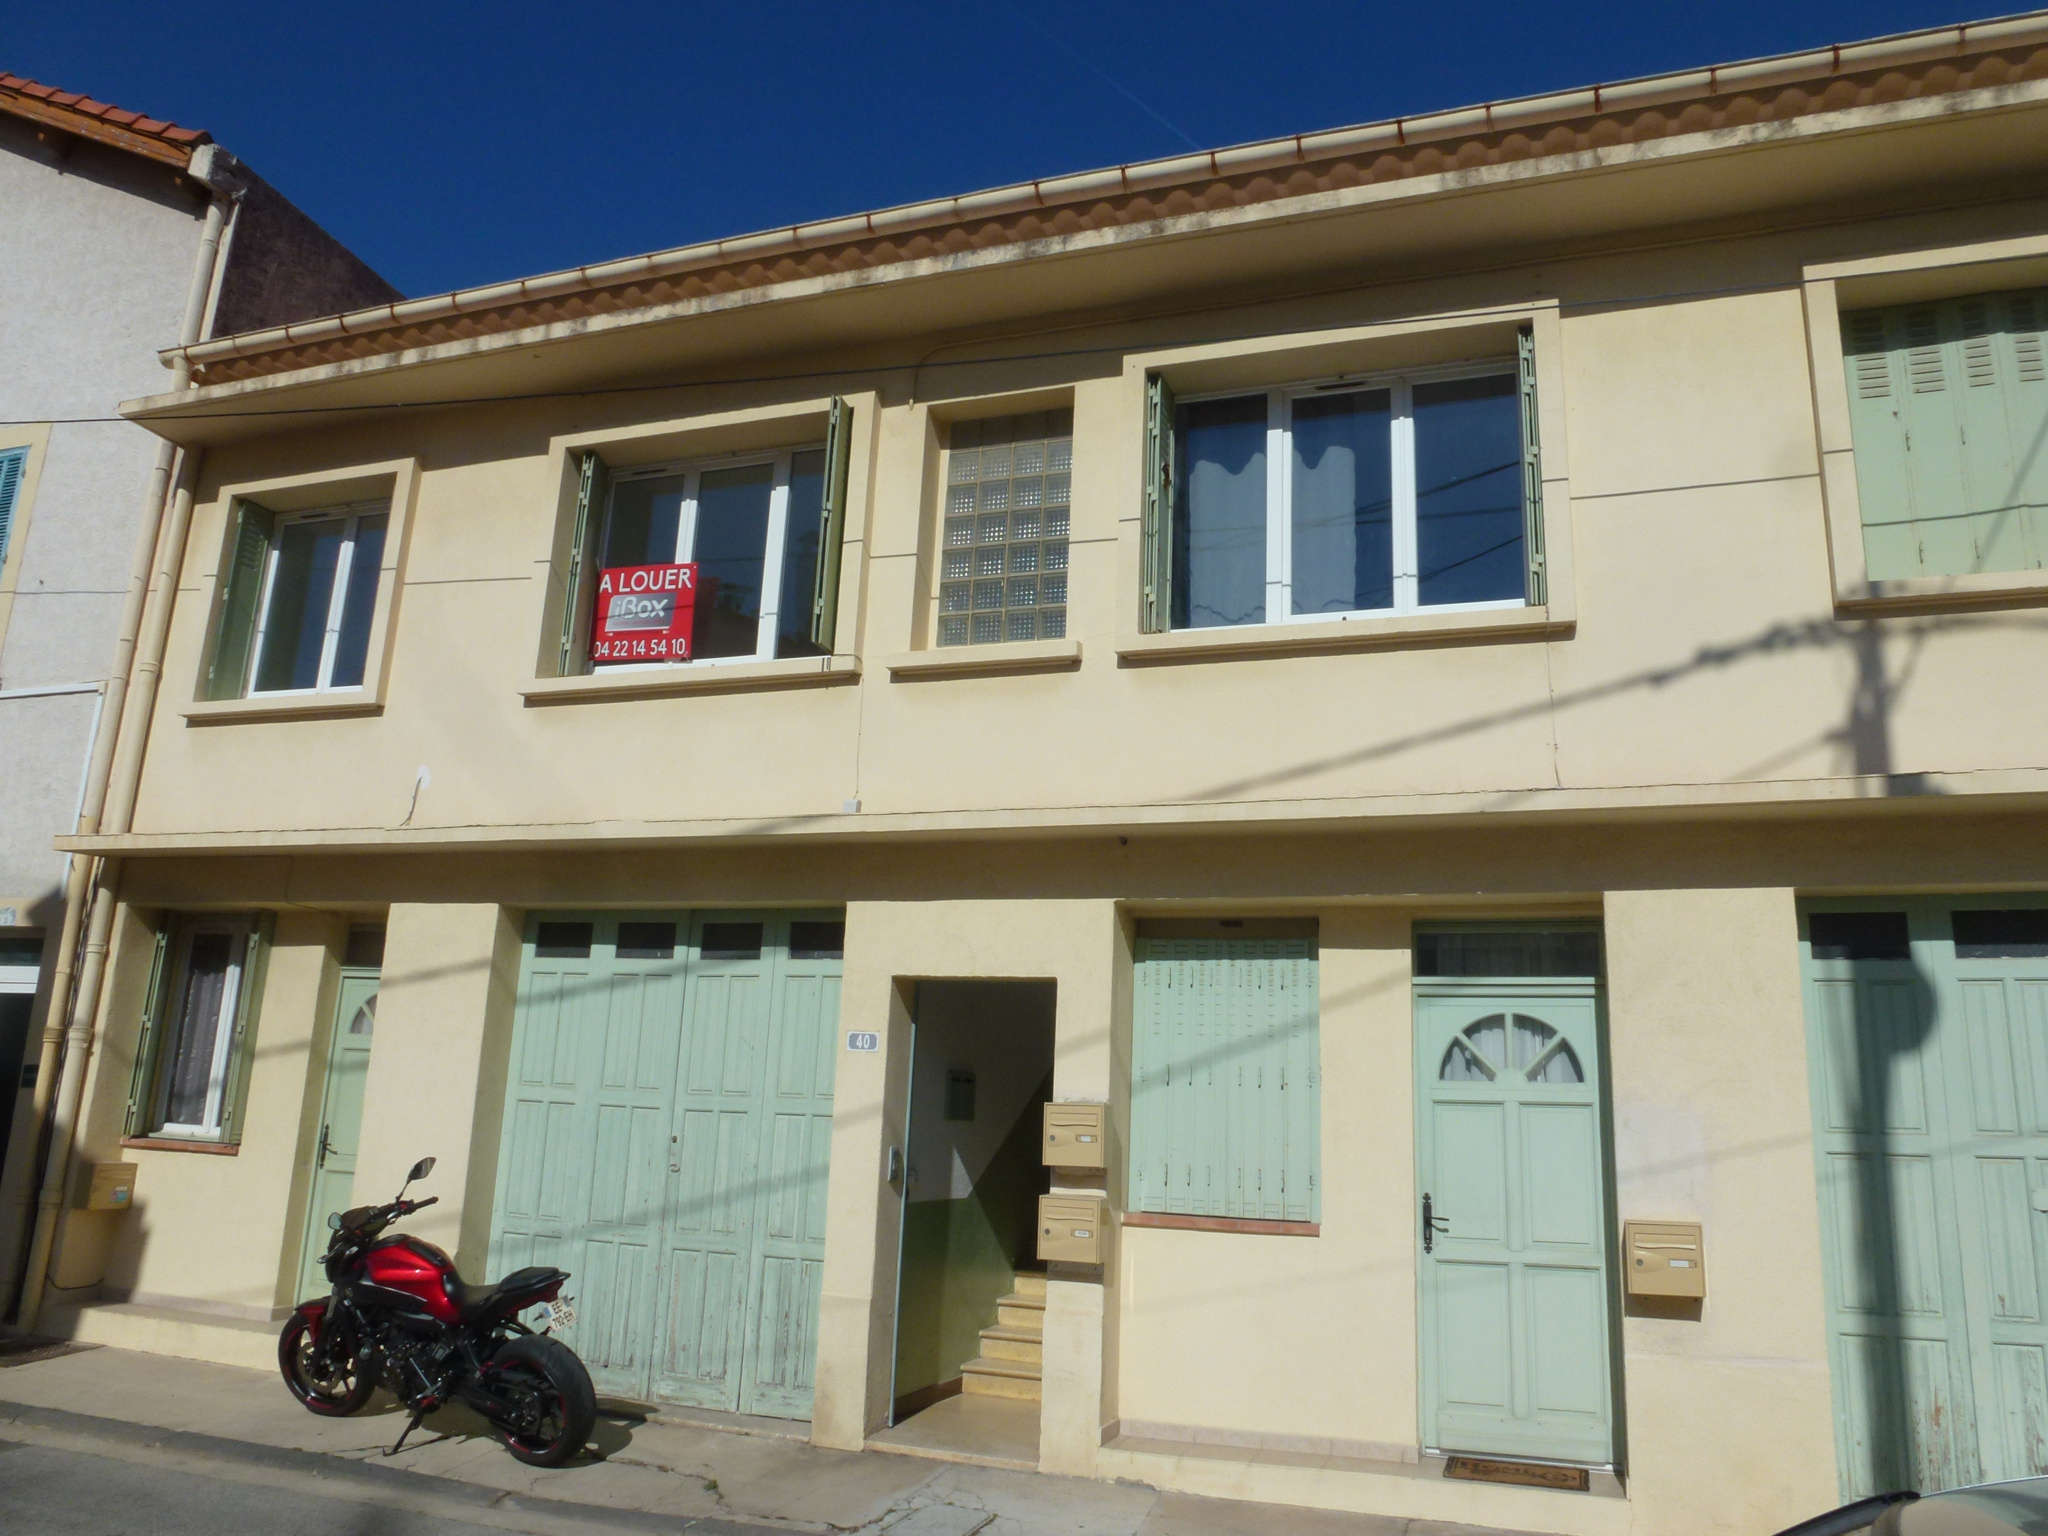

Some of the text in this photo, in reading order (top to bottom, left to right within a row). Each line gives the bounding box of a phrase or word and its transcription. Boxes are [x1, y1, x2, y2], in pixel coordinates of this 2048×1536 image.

[599, 568, 692, 593] A LOUER
[593, 638, 686, 657] 04 22 14 54 10
[856, 1034, 870, 1049] 40
